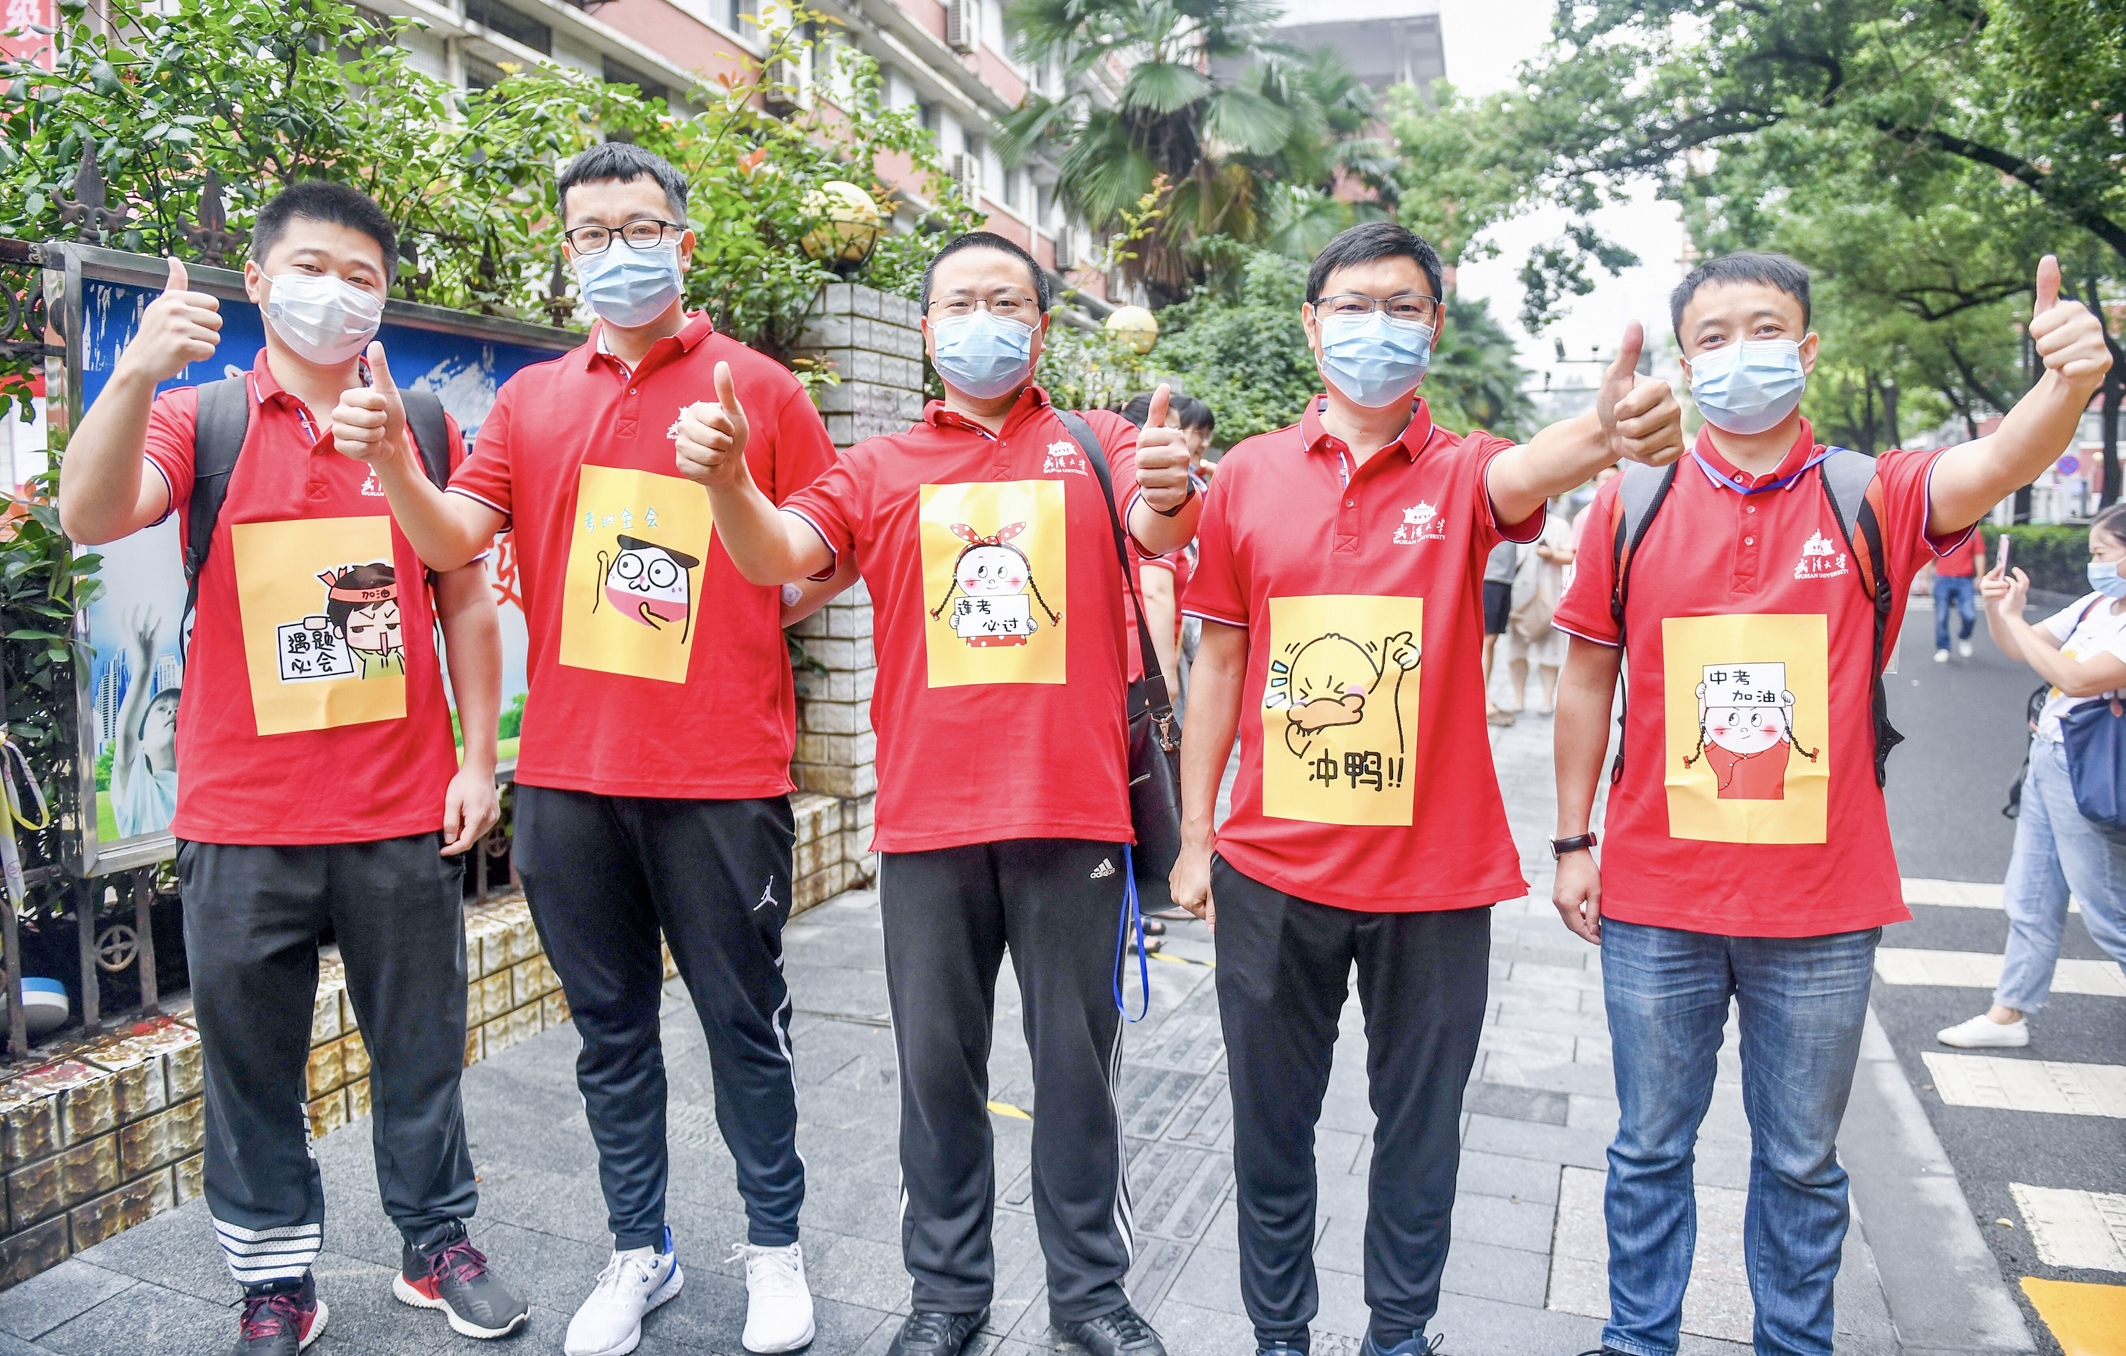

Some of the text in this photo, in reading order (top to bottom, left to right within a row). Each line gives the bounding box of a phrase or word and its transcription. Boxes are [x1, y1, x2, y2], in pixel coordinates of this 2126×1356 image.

[1793, 572, 1819, 580] WUHAN
[361, 588, 391, 600] 加油
[957, 598, 991, 616] 逢考
[982, 617, 1019, 633] 必过
[287, 630, 336, 654] 遇题
[291, 651, 337, 675] 必会
[1709, 669, 1750, 686] 中考
[1731, 689, 1776, 703] 加油
[1090, 867, 1116, 879] adidas
